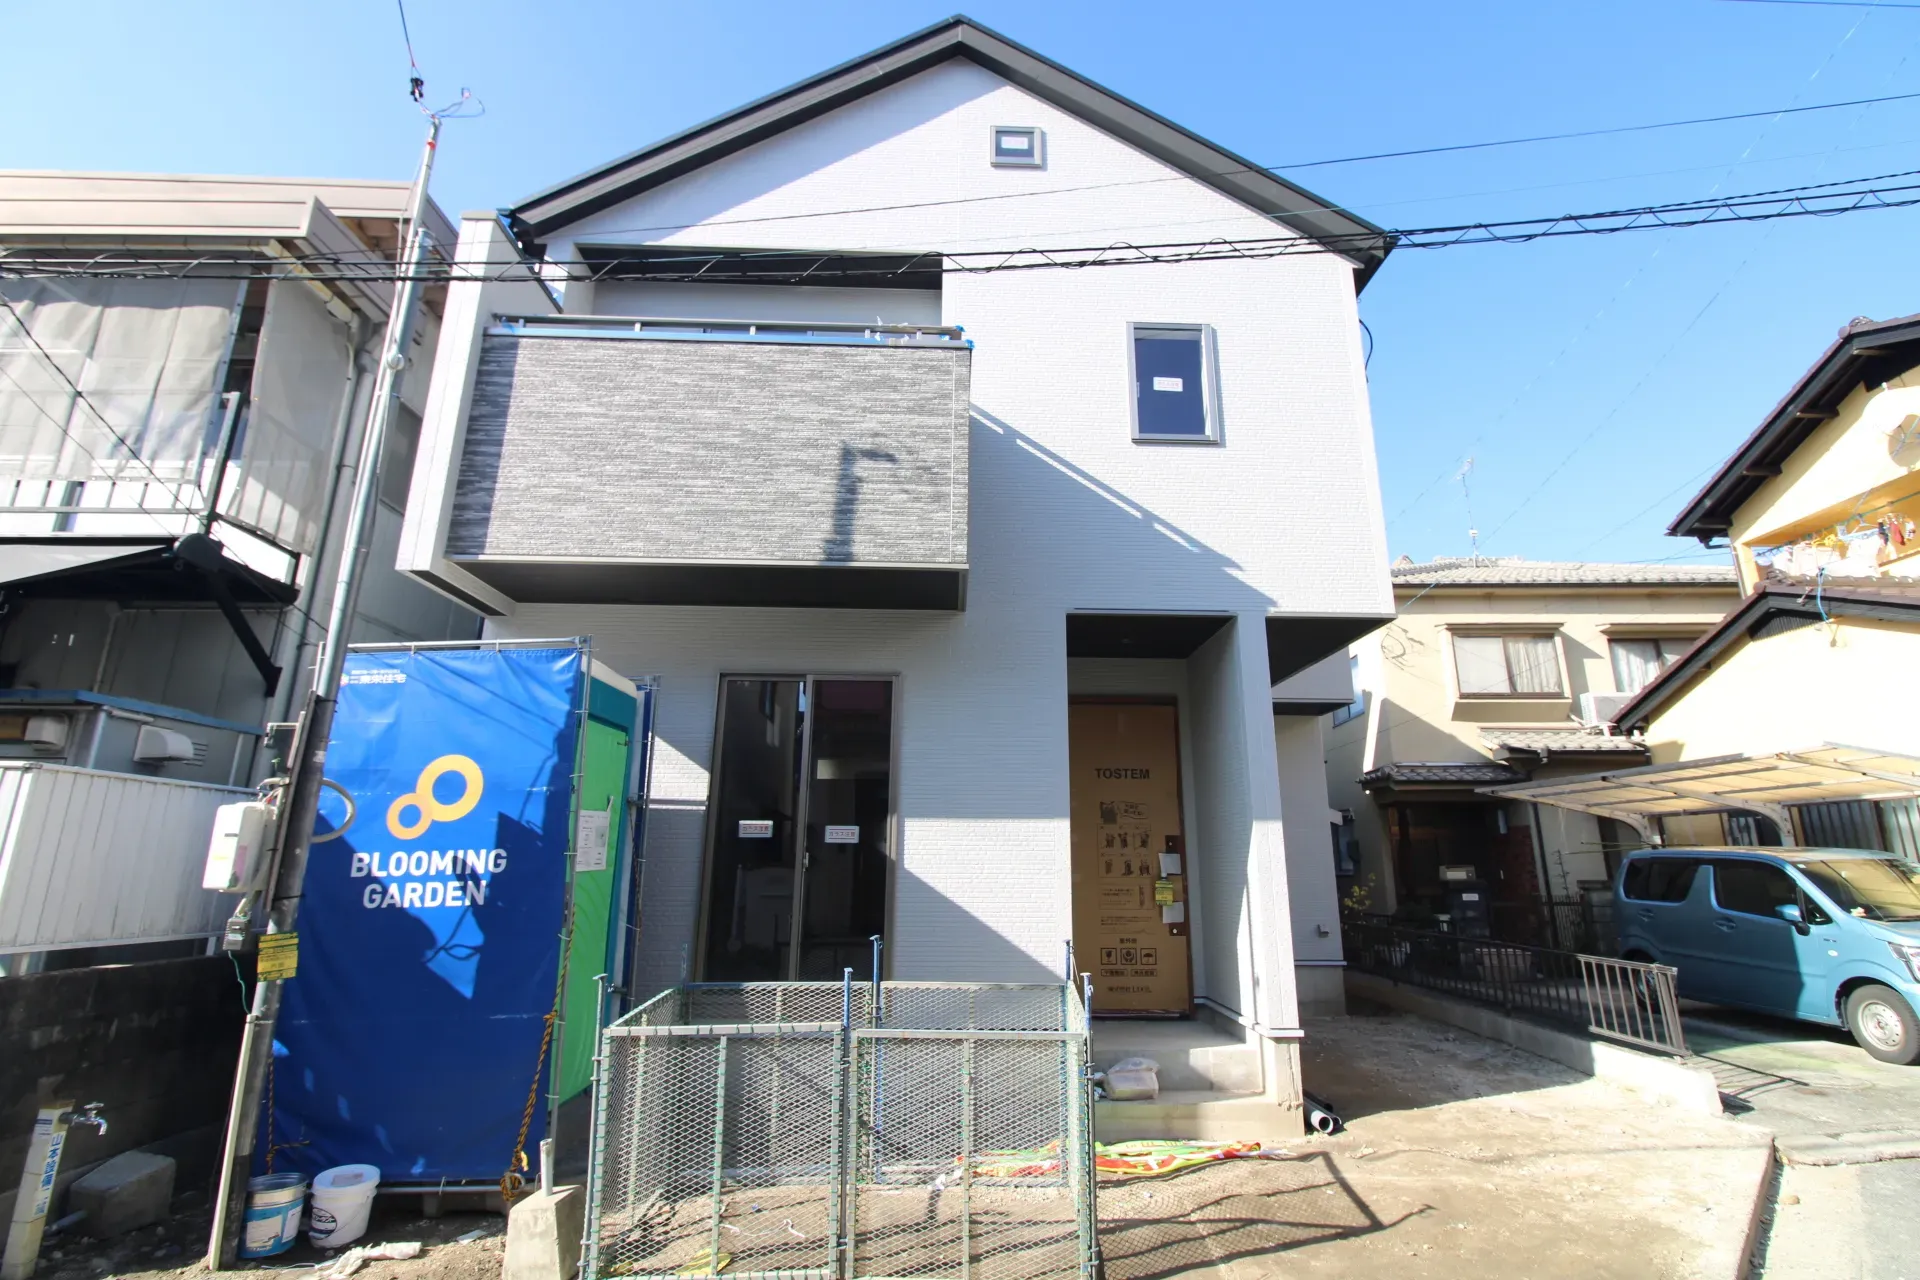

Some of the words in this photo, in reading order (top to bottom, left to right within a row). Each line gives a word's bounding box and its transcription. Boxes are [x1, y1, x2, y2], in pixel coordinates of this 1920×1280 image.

[1095, 767, 1150, 779] TOSTEM
[350, 849, 507, 877] BLOOMING
[362, 880, 487, 908] GARDEN
